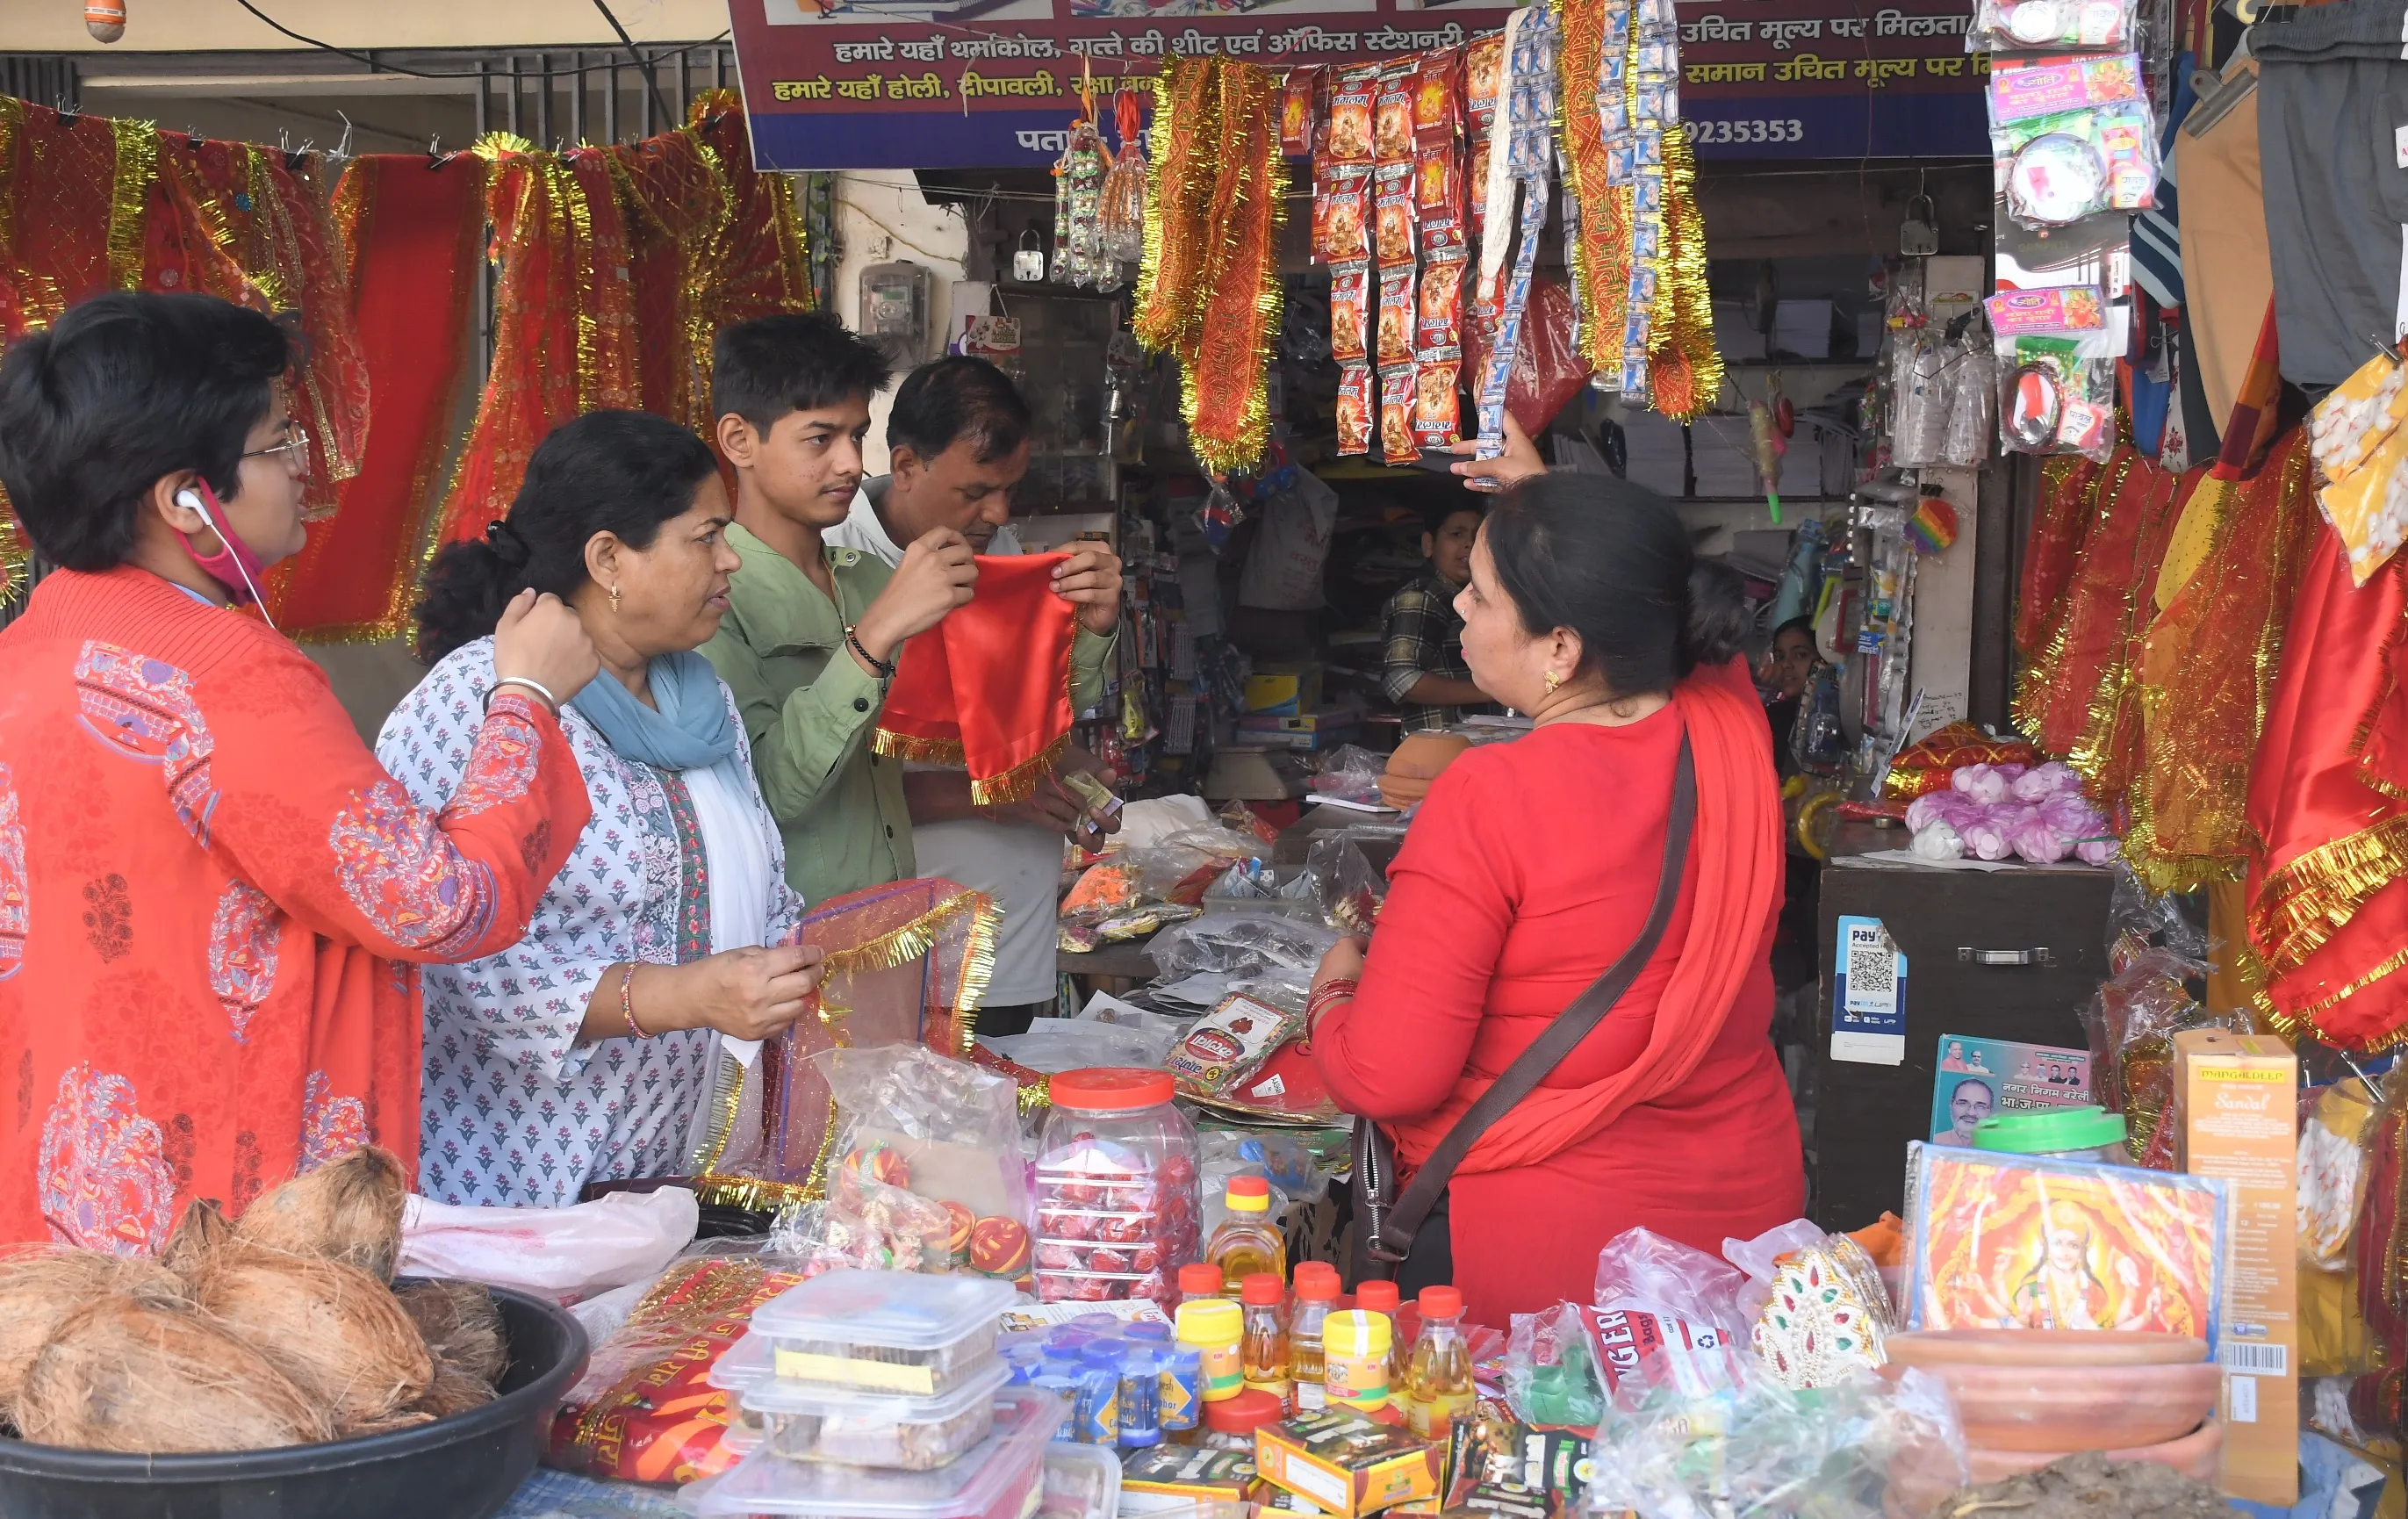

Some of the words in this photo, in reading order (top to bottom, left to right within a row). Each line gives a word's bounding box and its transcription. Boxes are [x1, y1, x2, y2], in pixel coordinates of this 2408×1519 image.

[834, 36, 895, 63] हमारे
[899, 33, 945, 60] यहाँ
[1129, 29, 1166, 54] की
[1172, 29, 1219, 54] शीट
[1225, 29, 1264, 53] एवं
[1268, 26, 1356, 53] ऑफिस
[1680, 16, 1752, 43] उचित
[1759, 18, 1822, 49] मूल्य
[1831, 18, 1868, 37] पर
[772, 75, 833, 101] हमारे
[836, 72, 881, 98] यहाँ
[886, 71, 950, 98] होली,
[1686, 61, 1765, 84] समान
[1773, 53, 1845, 81] उचित
[1854, 55, 1916, 87] मूल्य
[1926, 58, 1964, 76] पर
[1189, 1035, 1234, 1059] कलावा
[1170, 1056, 1203, 1074] गणेश
[2002, 1083, 2027, 1093] नगर
[2031, 1084, 2059, 1098] निगम
[2215, 1093, 2270, 1111] Sandal
